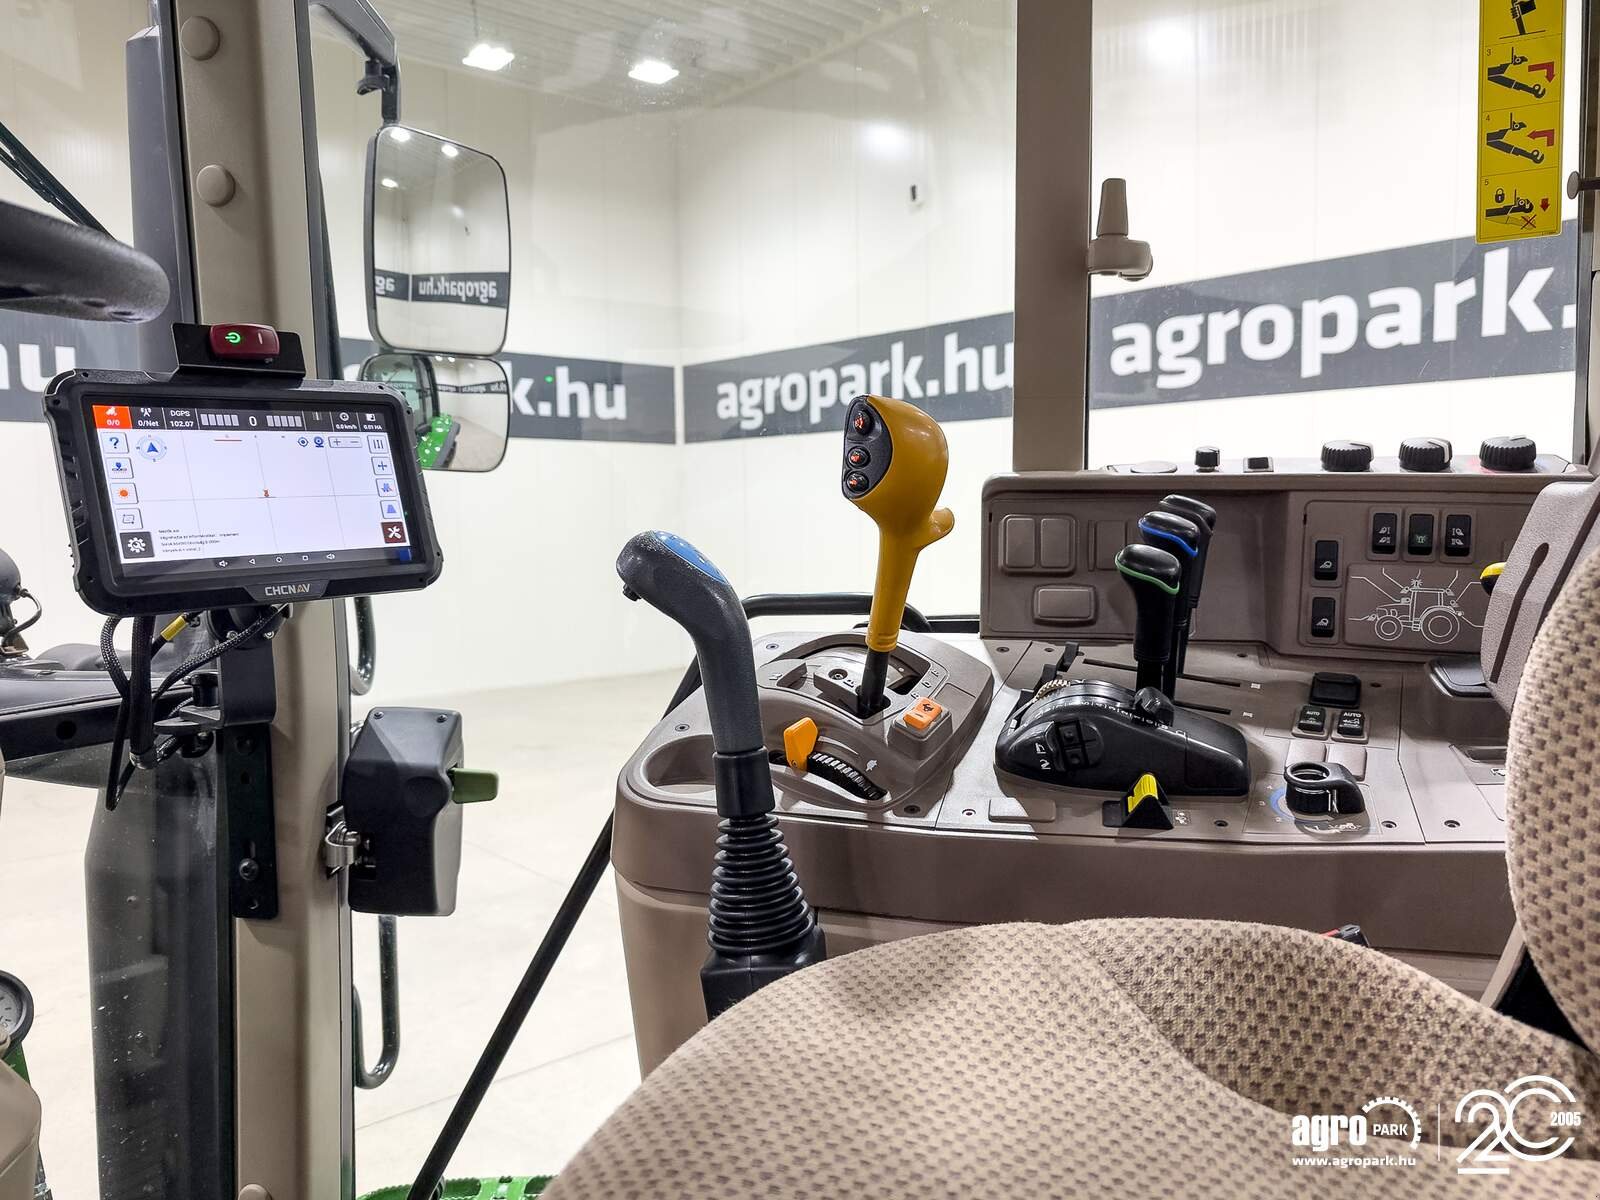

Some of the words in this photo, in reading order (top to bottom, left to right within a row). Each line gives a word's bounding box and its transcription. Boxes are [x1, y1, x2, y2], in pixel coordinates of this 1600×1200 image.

[1486, 49, 1492, 57] 3
[1485, 114, 1491, 122] 4
[1484, 178, 1490, 186] 5
[716, 332, 1014, 430] agropark.hu
[170, 420, 194, 428] 102.07
[249, 415, 258, 427] 0
[264, 583, 310, 596] CHCNAV
